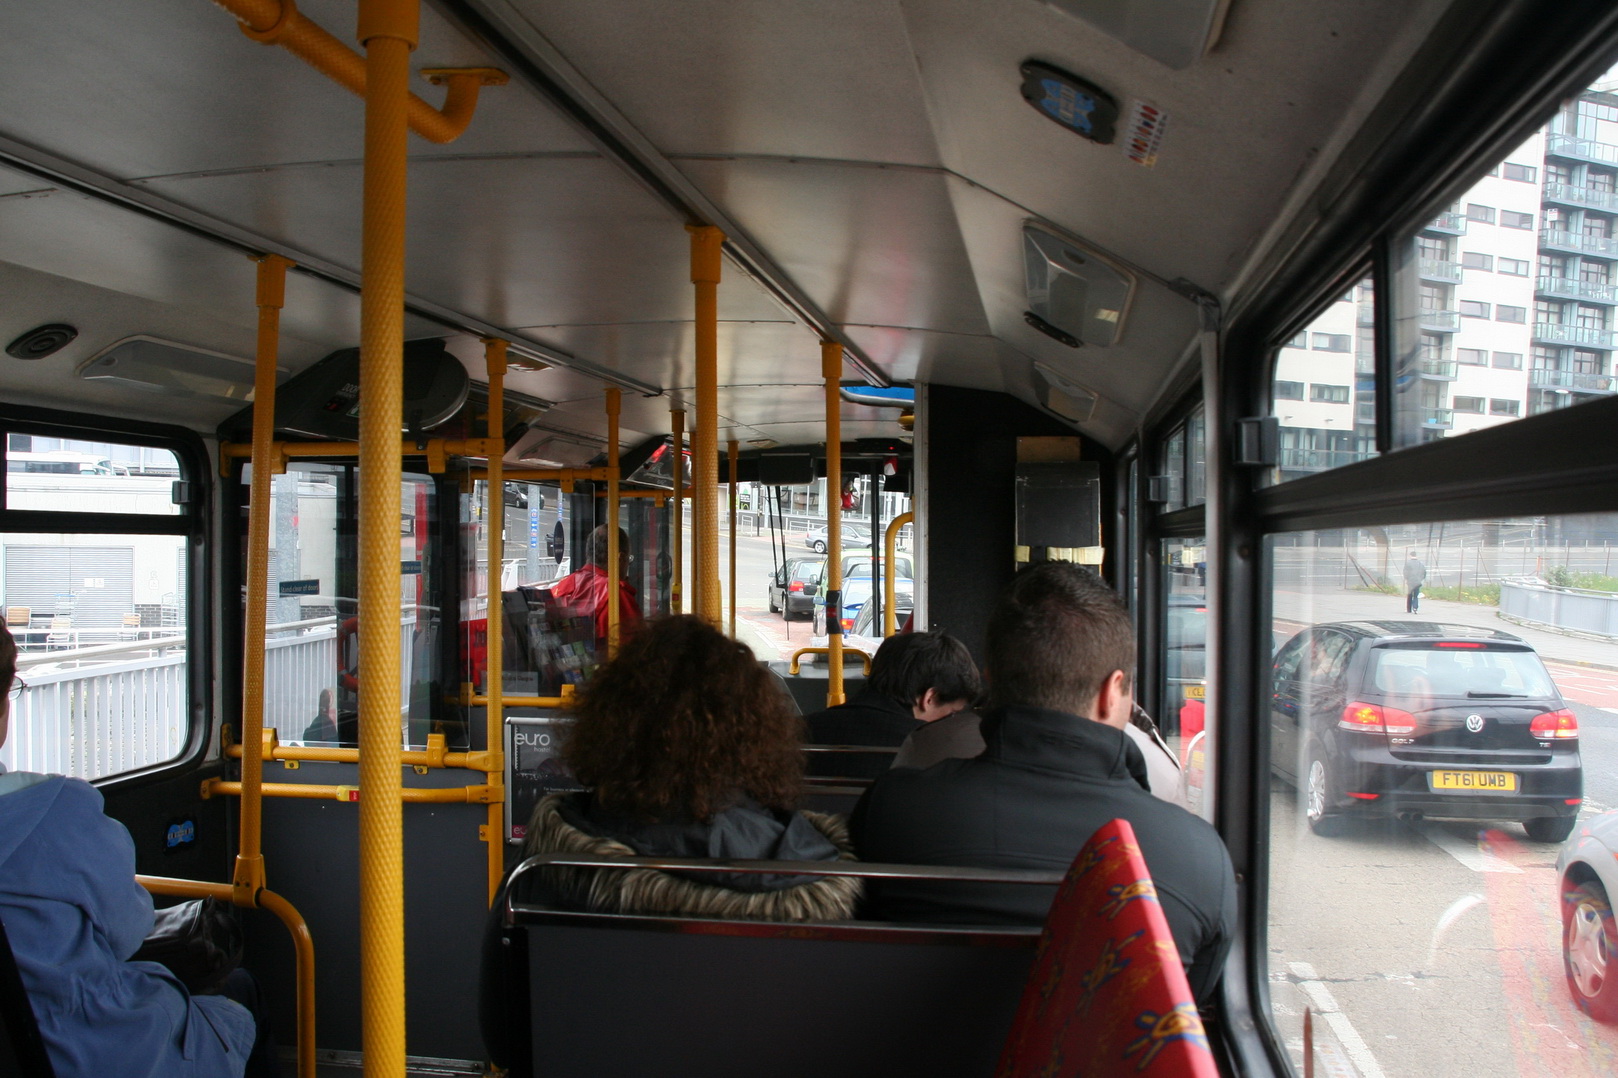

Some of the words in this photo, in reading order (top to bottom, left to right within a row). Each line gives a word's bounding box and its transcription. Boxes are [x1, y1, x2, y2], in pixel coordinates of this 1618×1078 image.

[514, 732, 551, 746] euro
[1443, 772, 1475, 787] FT61
[1479, 773, 1507, 788] UMB
